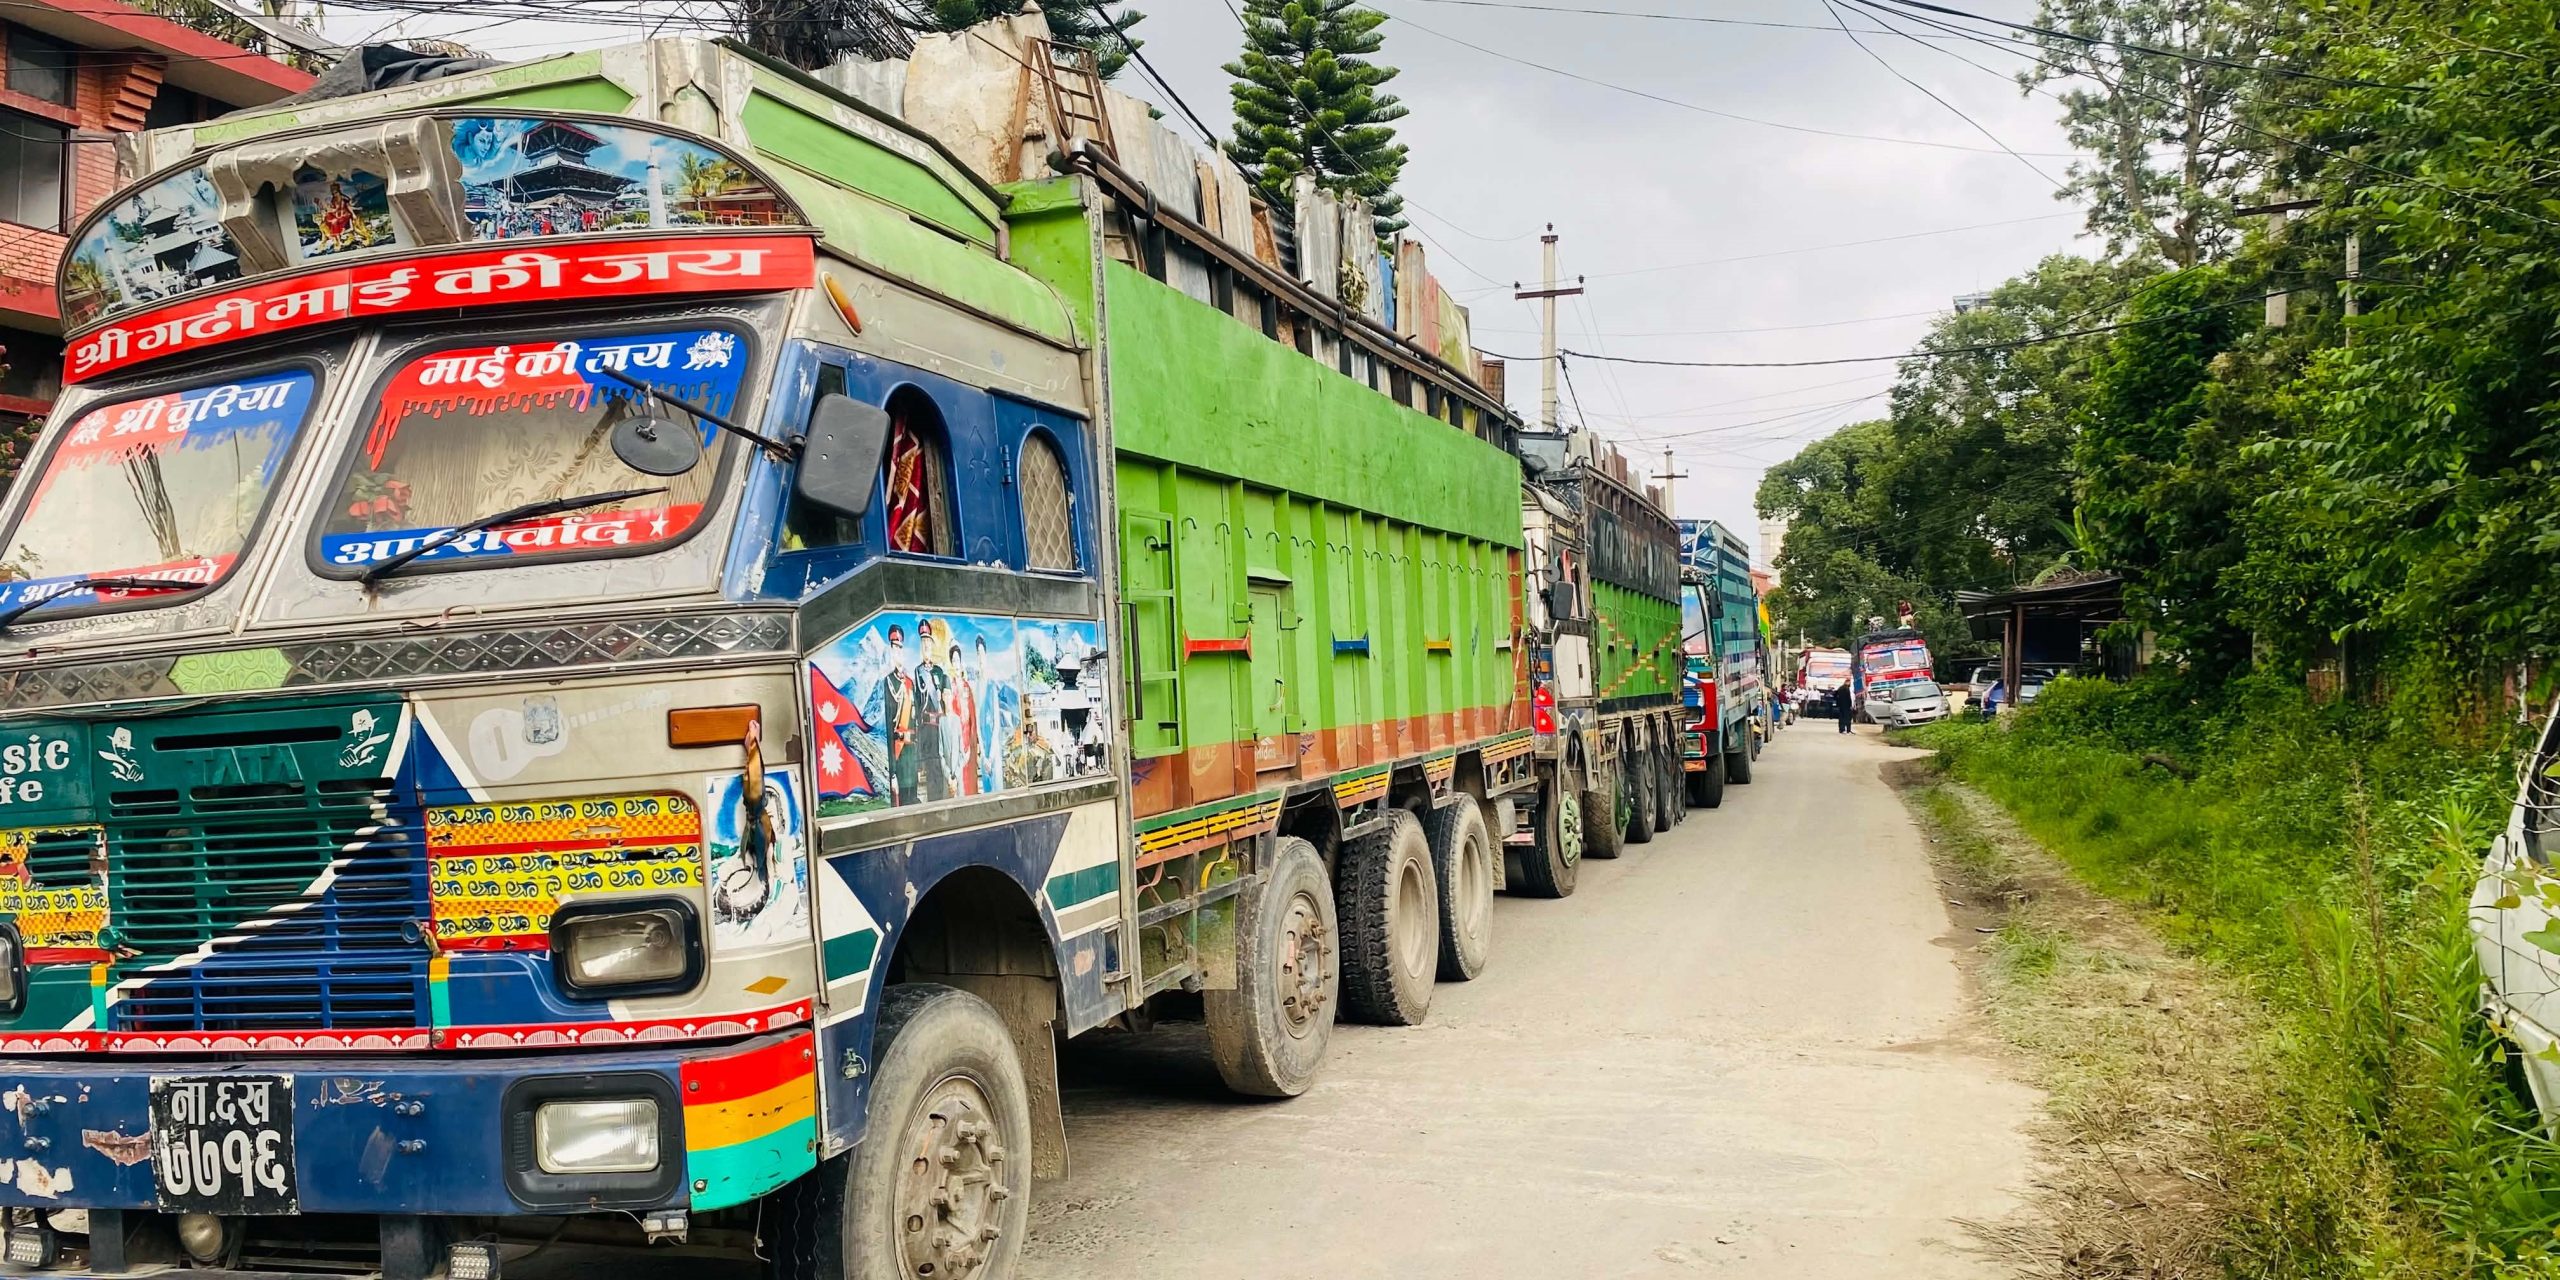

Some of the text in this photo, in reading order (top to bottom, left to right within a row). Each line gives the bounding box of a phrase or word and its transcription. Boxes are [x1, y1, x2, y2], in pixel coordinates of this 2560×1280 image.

[74, 327, 136, 375] श्री
[265, 267, 420, 320] माई
[434, 252, 571, 295] की
[578, 249, 772, 283] जय
[418, 341, 678, 388] माई की जय
[107, 381, 296, 438] श्री चुरिया
[2, 734, 70, 775] sic
[184, 744, 304, 786] TATA
[158, 1128, 289, 1197] ७७१६
